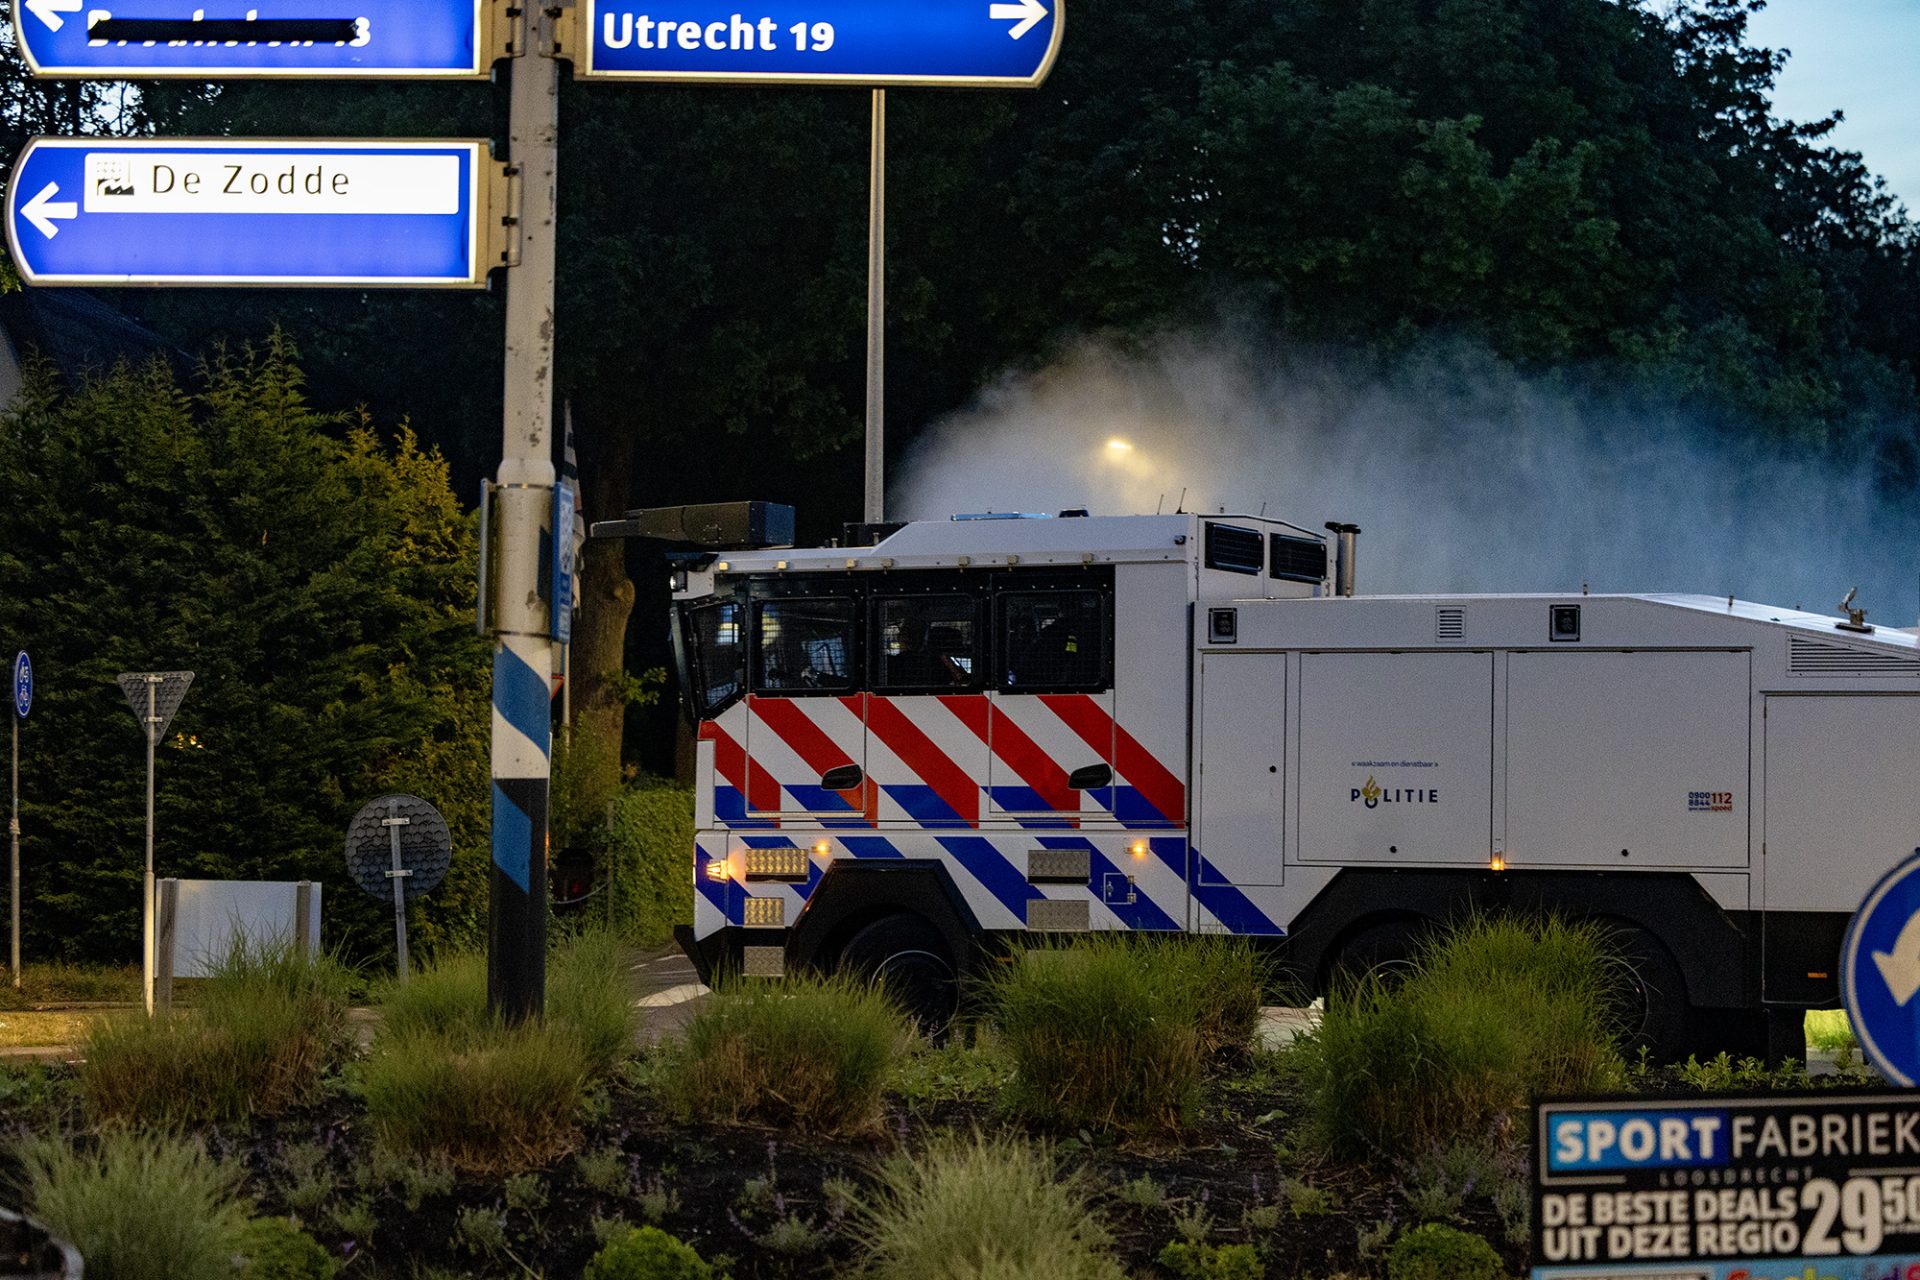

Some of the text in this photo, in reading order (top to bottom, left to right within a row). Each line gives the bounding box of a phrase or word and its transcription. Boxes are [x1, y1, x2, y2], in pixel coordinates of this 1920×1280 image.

[604, 13, 835, 51] Utrecht 19
[153, 165, 350, 194] De Zodde
[1351, 788, 1438, 809] POLITIE
[1711, 792, 1732, 804] 112
[1556, 1112, 1920, 1163] SPORT FABRIEK
[1542, 1187, 1798, 1226] DE BESTE DEALS
[1543, 1220, 1799, 1261] UIT DEZE REGIO
